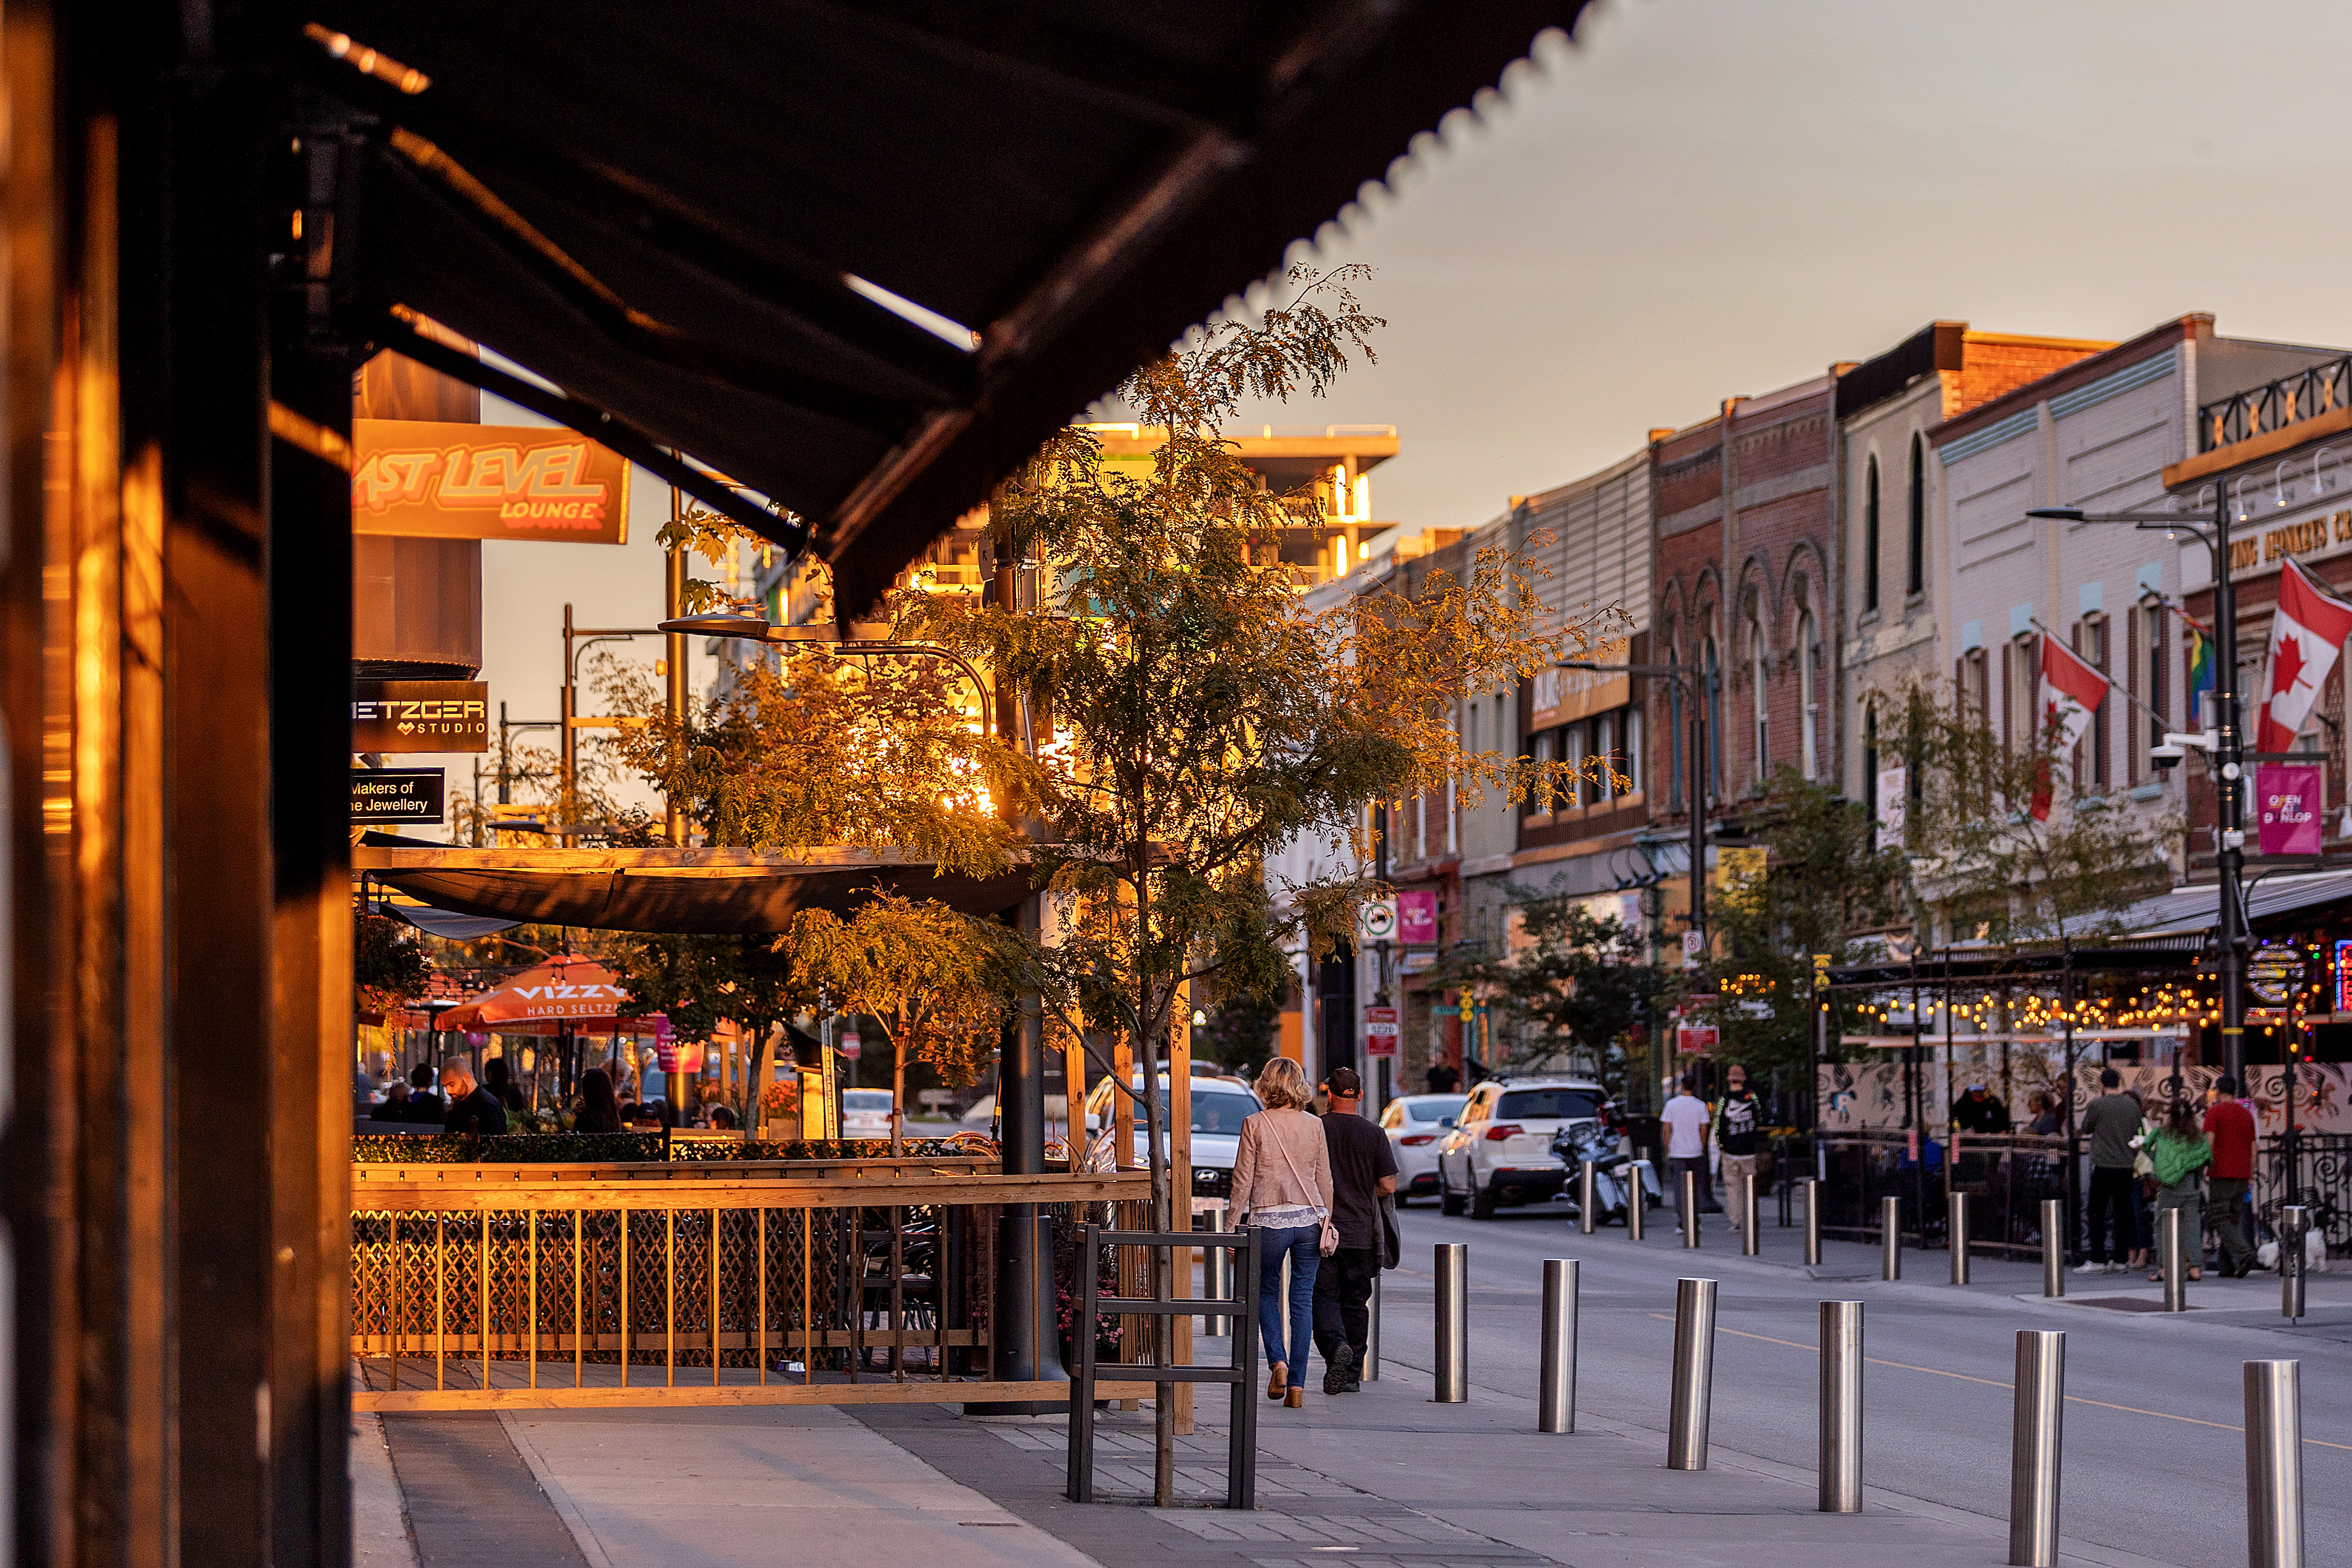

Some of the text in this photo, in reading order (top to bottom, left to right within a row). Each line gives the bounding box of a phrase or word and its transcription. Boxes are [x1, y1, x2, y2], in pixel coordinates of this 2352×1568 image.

[352, 444, 605, 502] AST LEVEL
[500, 502, 598, 519] LOUNGE
[417, 722, 485, 733] STUDIO
[400, 781, 414, 794] of
[366, 799, 428, 813] Jewellery
[512, 984, 627, 1000] VIZZY
[527, 1003, 618, 1017] HARD SELTZ
